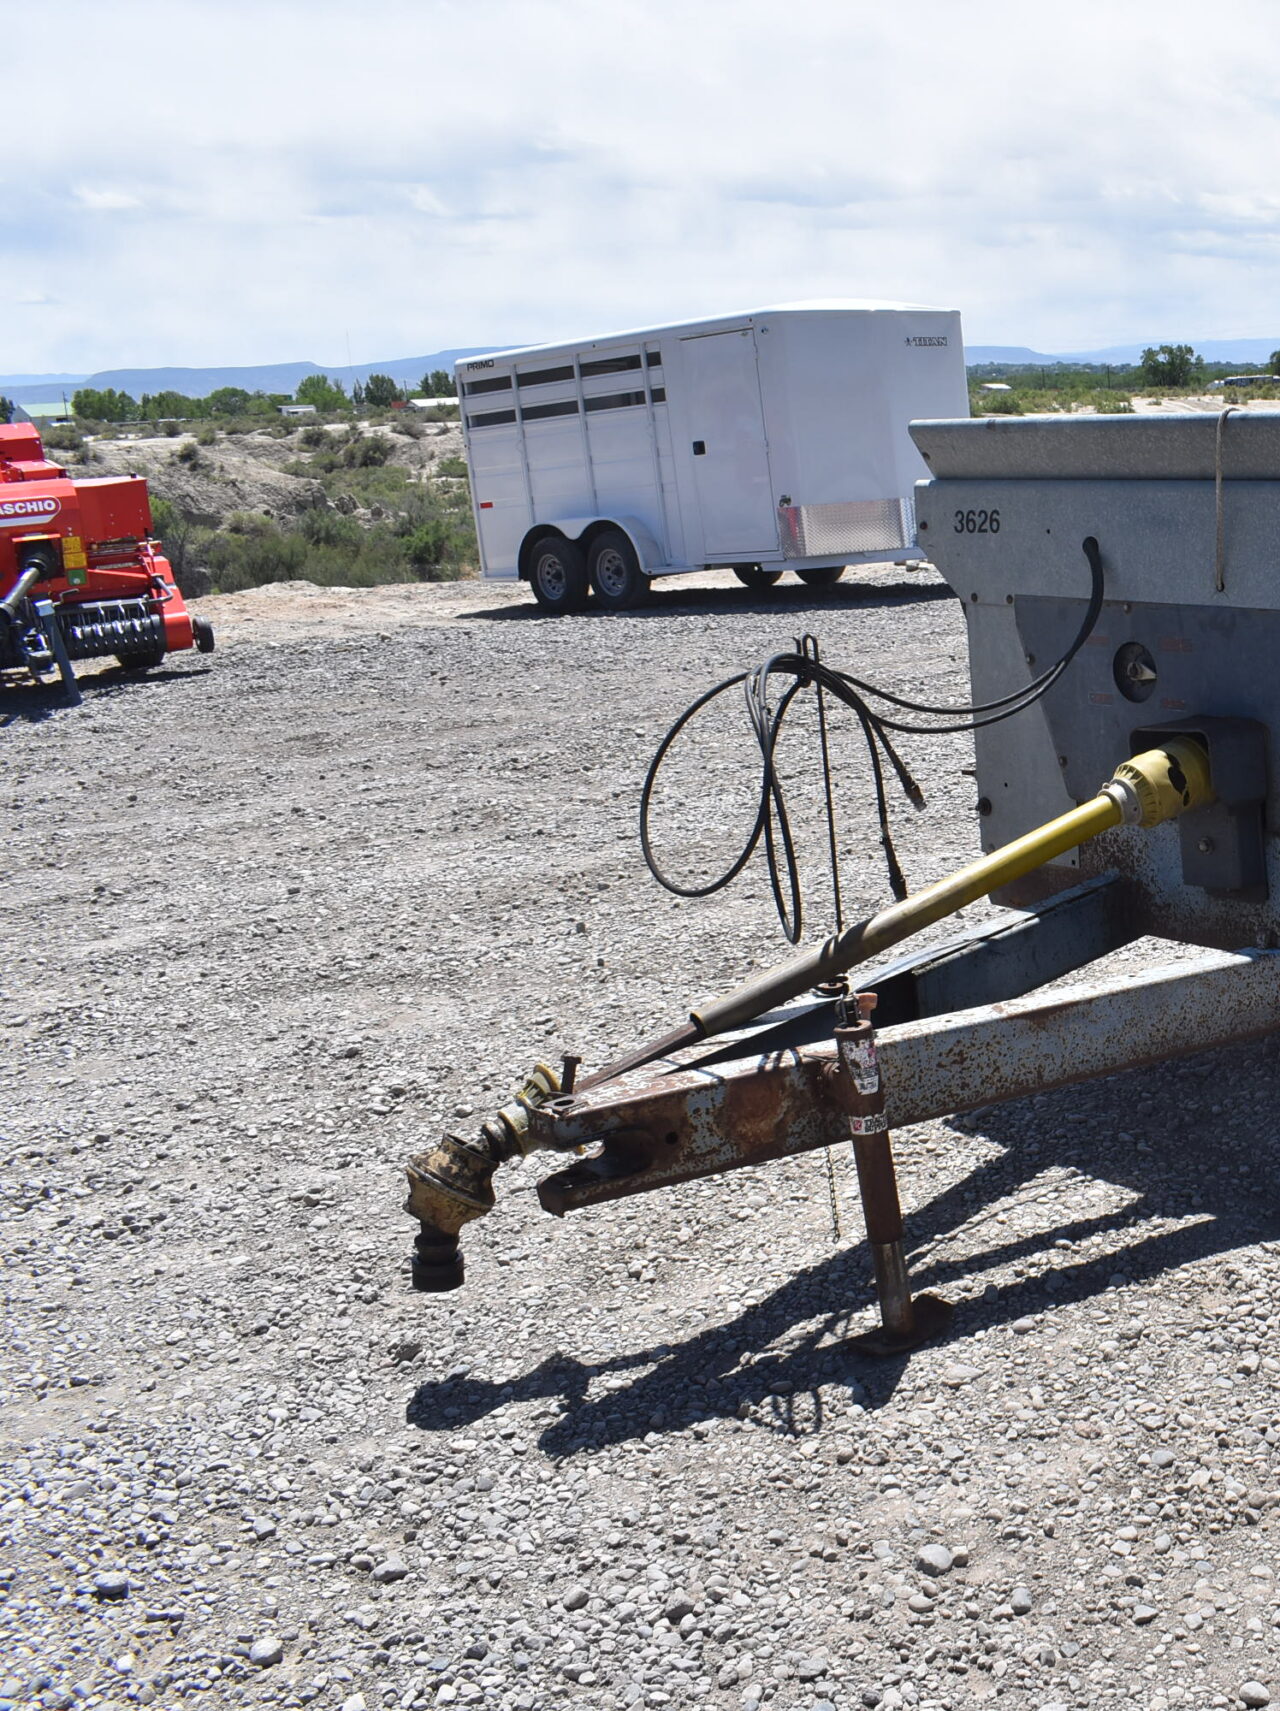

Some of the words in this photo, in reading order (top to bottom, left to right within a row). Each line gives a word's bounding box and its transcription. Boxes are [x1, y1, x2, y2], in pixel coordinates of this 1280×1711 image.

[912, 336, 948, 347] TITAN
[466, 359, 495, 371] PRIMO
[953, 509, 1000, 534] 3626
